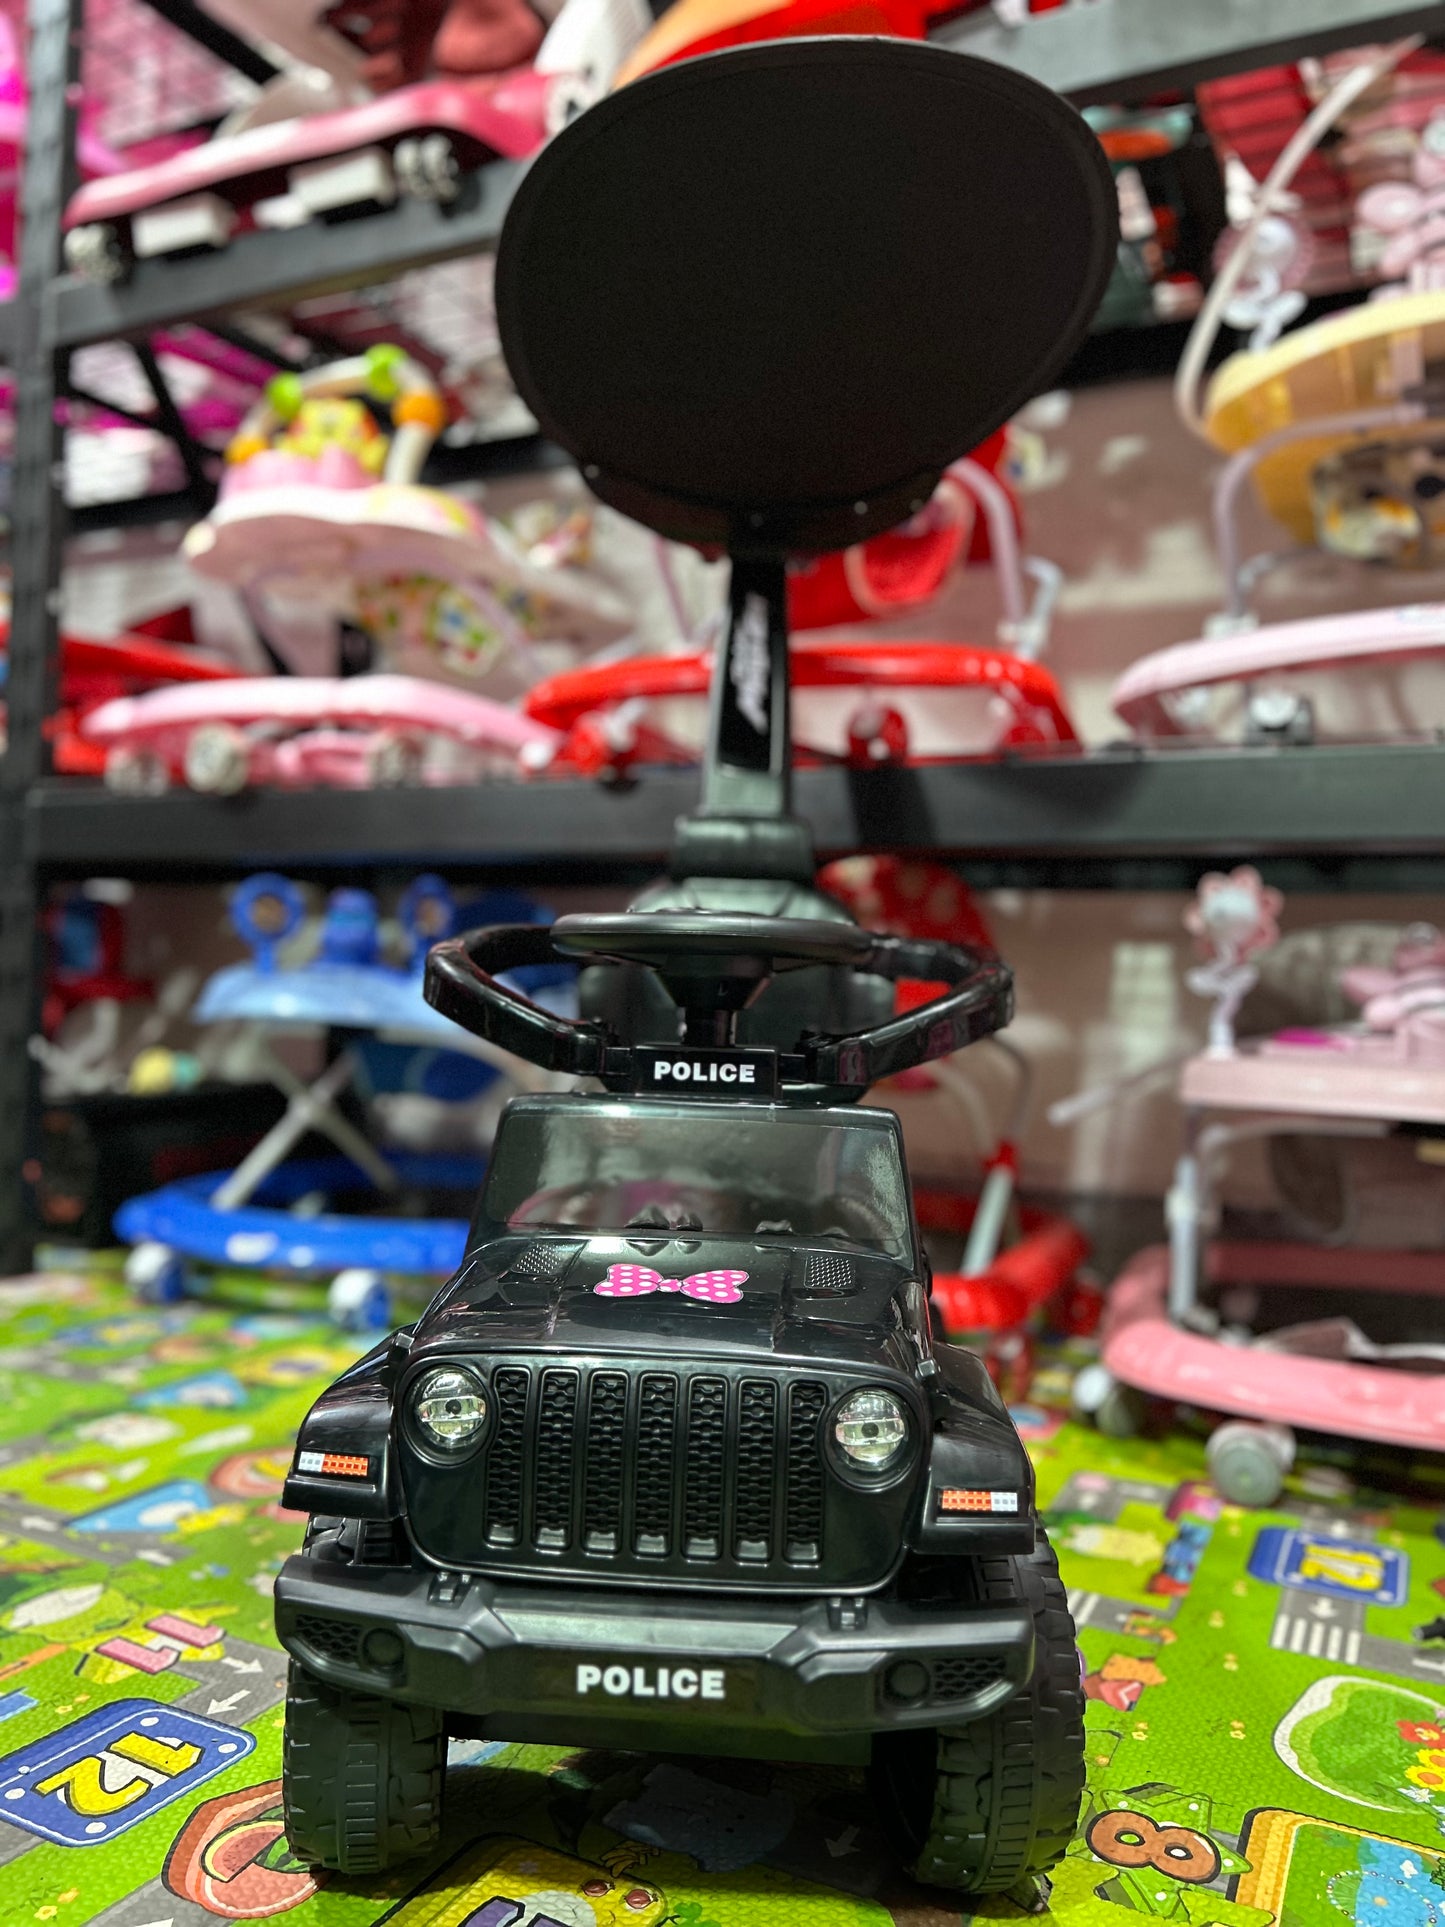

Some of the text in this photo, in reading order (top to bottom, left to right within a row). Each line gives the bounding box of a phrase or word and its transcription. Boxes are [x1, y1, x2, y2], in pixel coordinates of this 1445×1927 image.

[654, 1061, 756, 1083] POLICE
[576, 1664, 726, 1699] POLICE
[30, 1730, 206, 1818] 12
[1085, 1809, 1222, 1884] 8
